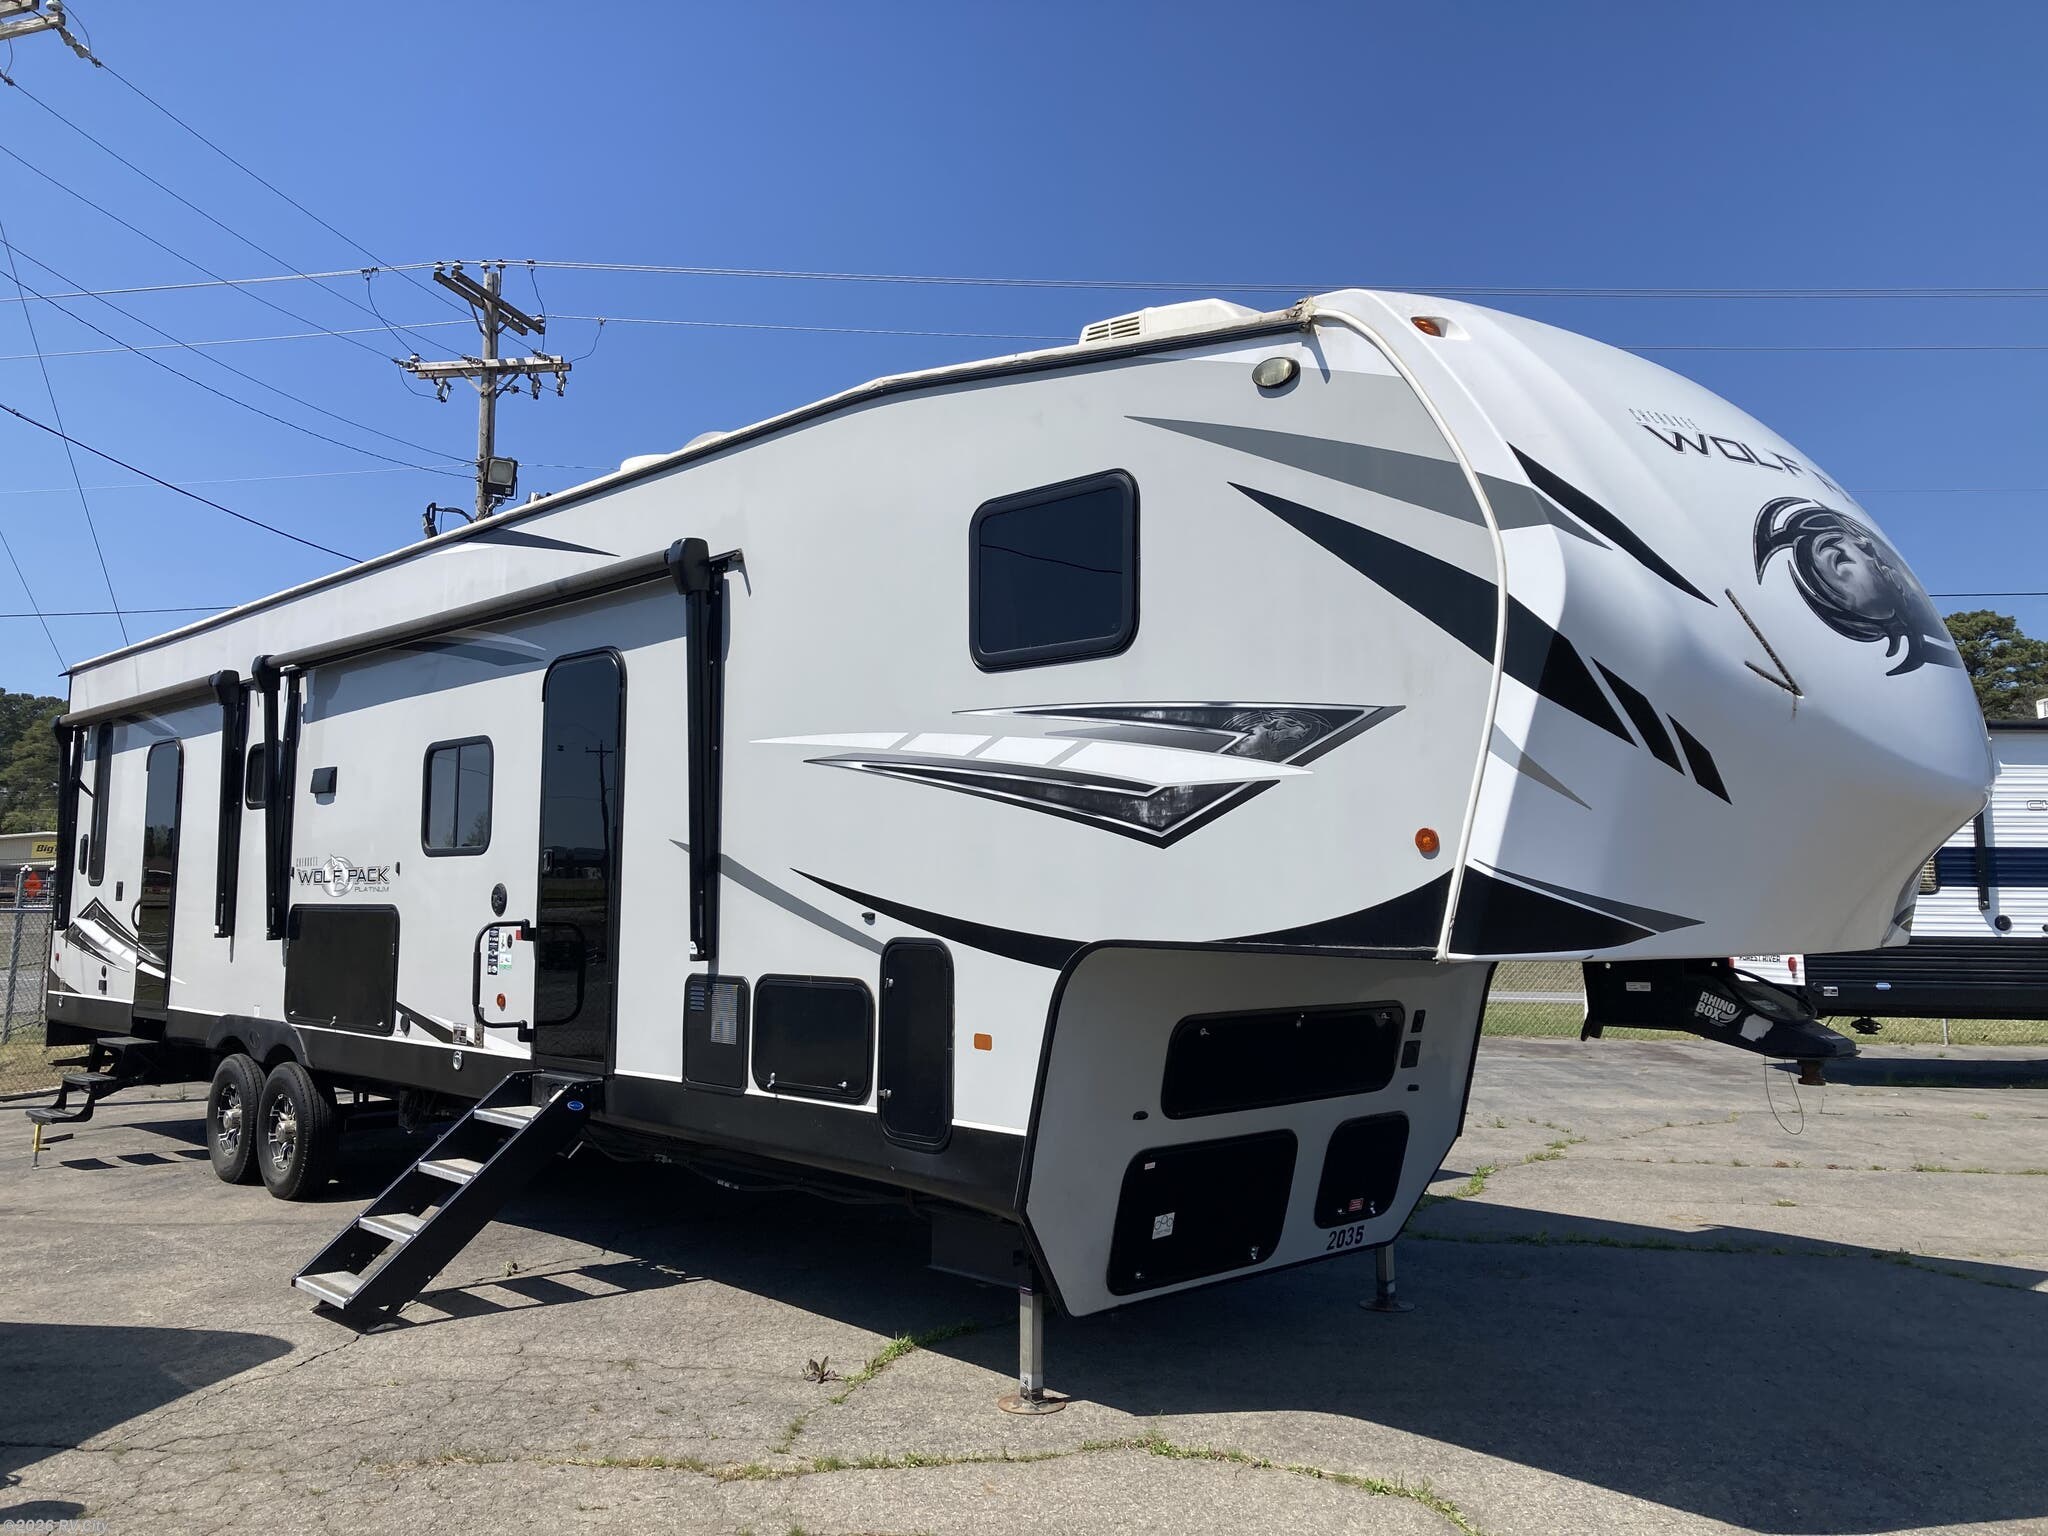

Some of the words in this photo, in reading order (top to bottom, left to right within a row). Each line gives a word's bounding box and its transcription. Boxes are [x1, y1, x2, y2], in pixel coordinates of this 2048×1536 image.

[1635, 422, 1804, 477] WOLF
[297, 868, 343, 885] WOLF
[347, 866, 390, 885] PACK
[1695, 1001, 1721, 1020] BOX
[1700, 991, 1736, 1014] RHINO
[1326, 1225, 1365, 1251] 2035
